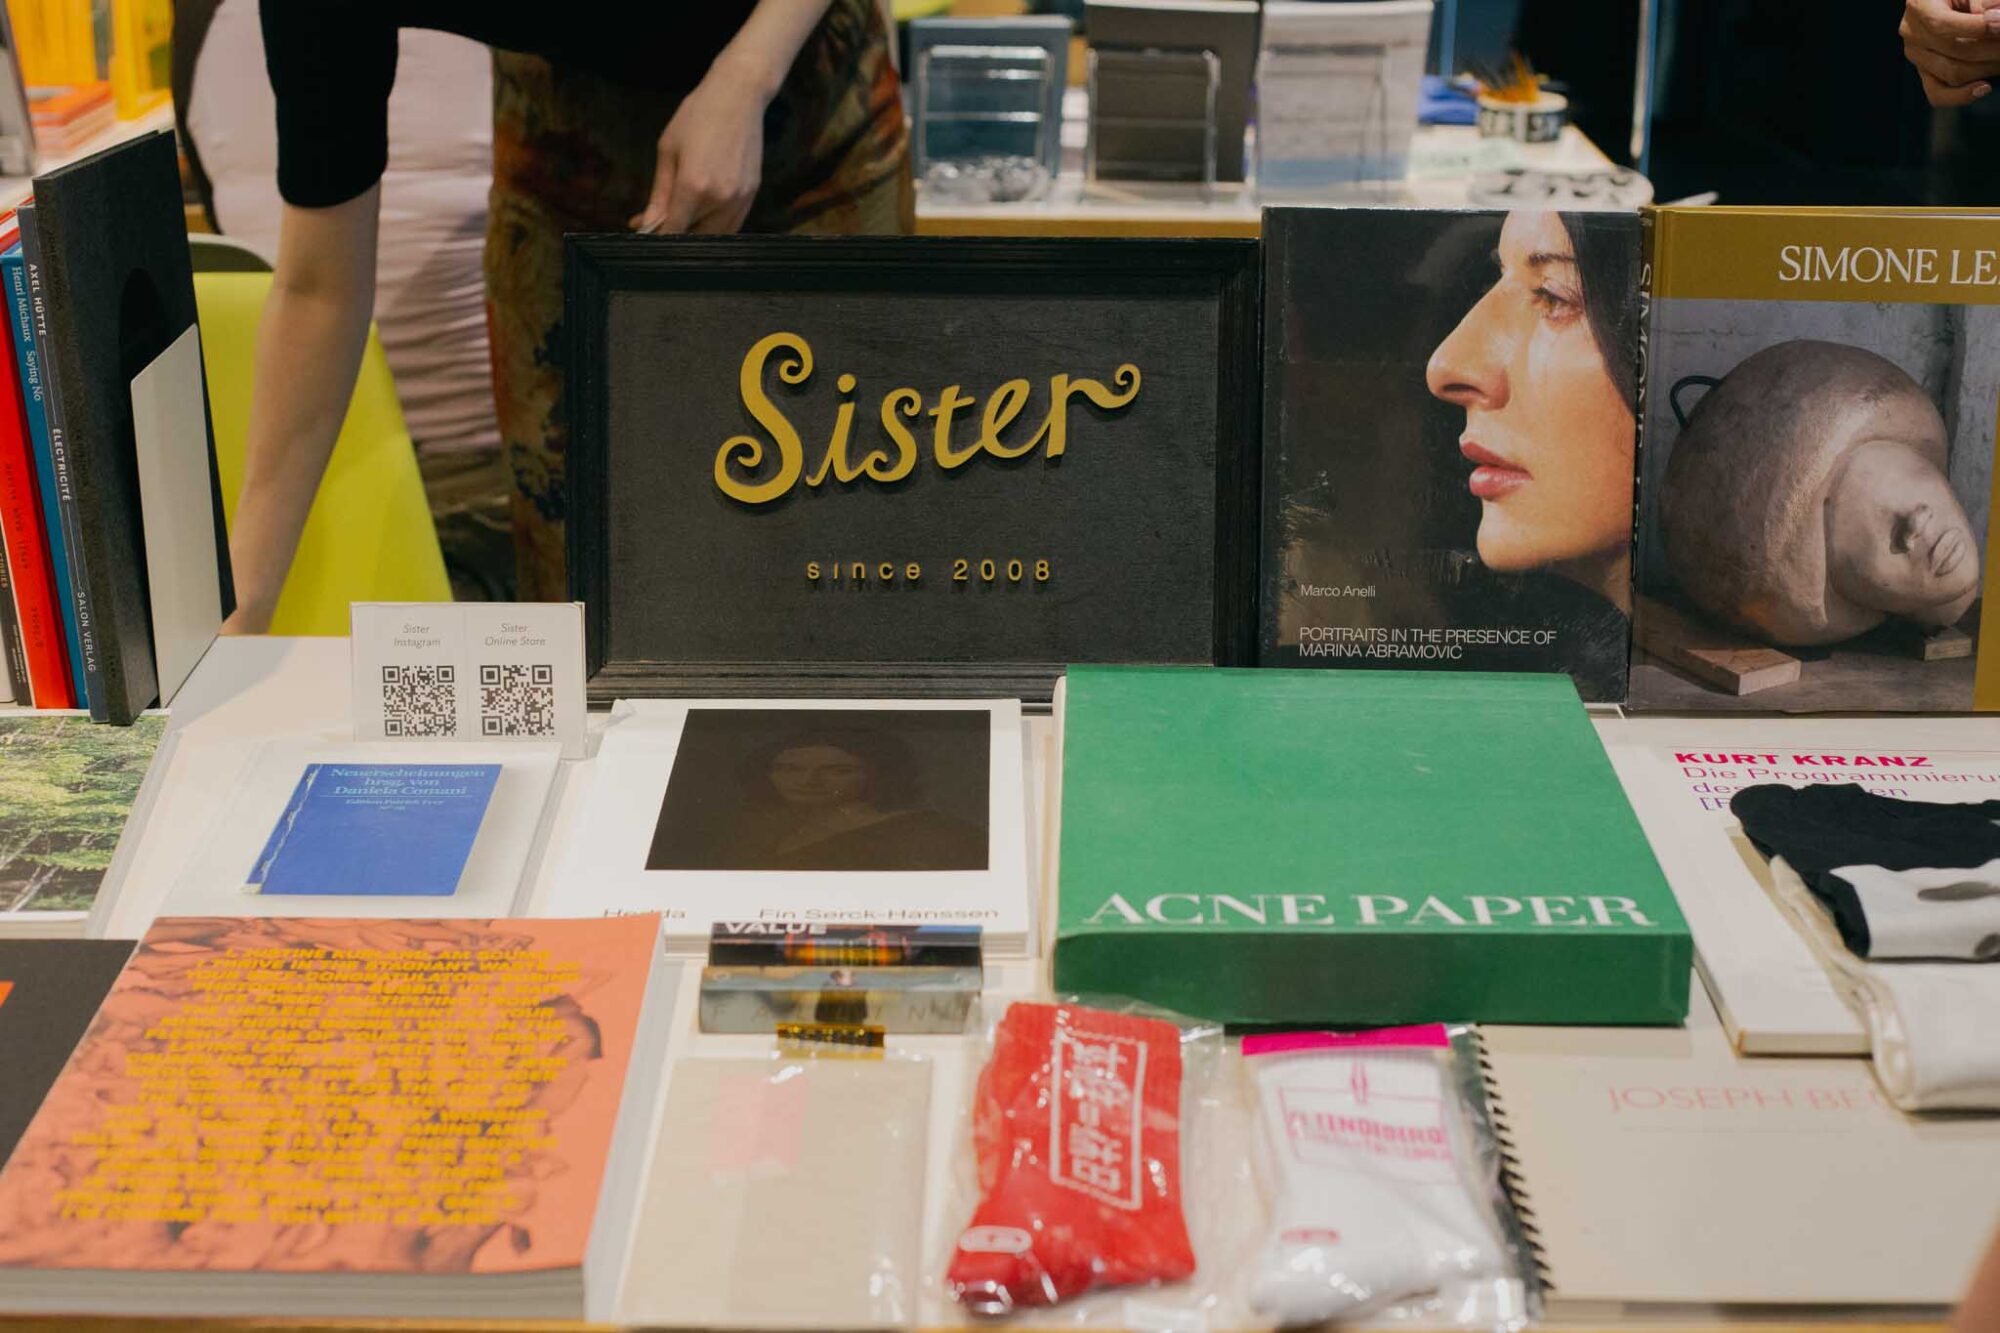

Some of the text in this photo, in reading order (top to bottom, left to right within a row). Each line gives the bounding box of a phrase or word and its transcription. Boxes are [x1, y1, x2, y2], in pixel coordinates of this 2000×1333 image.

[1778, 245, 2000, 285] SIMONE LE
[29, 263, 48, 337] AXEL HÜTTE
[11, 266, 42, 402] Henri Michaux Saying No
[714, 332, 1142, 504] Sister
[52, 428, 72, 502] ÉLECTRICITÉ
[806, 559, 1051, 581] since 2008
[1300, 584, 1376, 598] Marco Anelli
[77, 591, 97, 673] SALON VERLAG
[402, 623, 431, 634] Sister
[500, 622, 529, 633] Sister
[393, 637, 441, 649] Instagram
[484, 636, 547, 646] Online Store
[1299, 627, 1557, 645] PORTRAITS IN THE PRESENCE OF
[1299, 643, 1463, 660] MARINA ABRAMOVIĆ
[1673, 752, 1935, 768] KURT KRANZ
[409, 779, 440, 787] von
[1683, 767, 2000, 783] Die Programmieru
[334, 785, 468, 796] Daniela Comani
[758, 908, 797, 919] Fin
[1083, 892, 1660, 928] ACNE PAPER
[724, 921, 828, 935] VALUE
[437, 949, 472, 960] AM
[211, 959, 283, 970] THRIVE
[290, 960, 312, 971] IN
[321, 960, 359, 971] THE
[365, 961, 471, 972] STAGNANT
[479, 961, 547, 973] WASTE
[1608, 1084, 1795, 1114] JOSEPH
